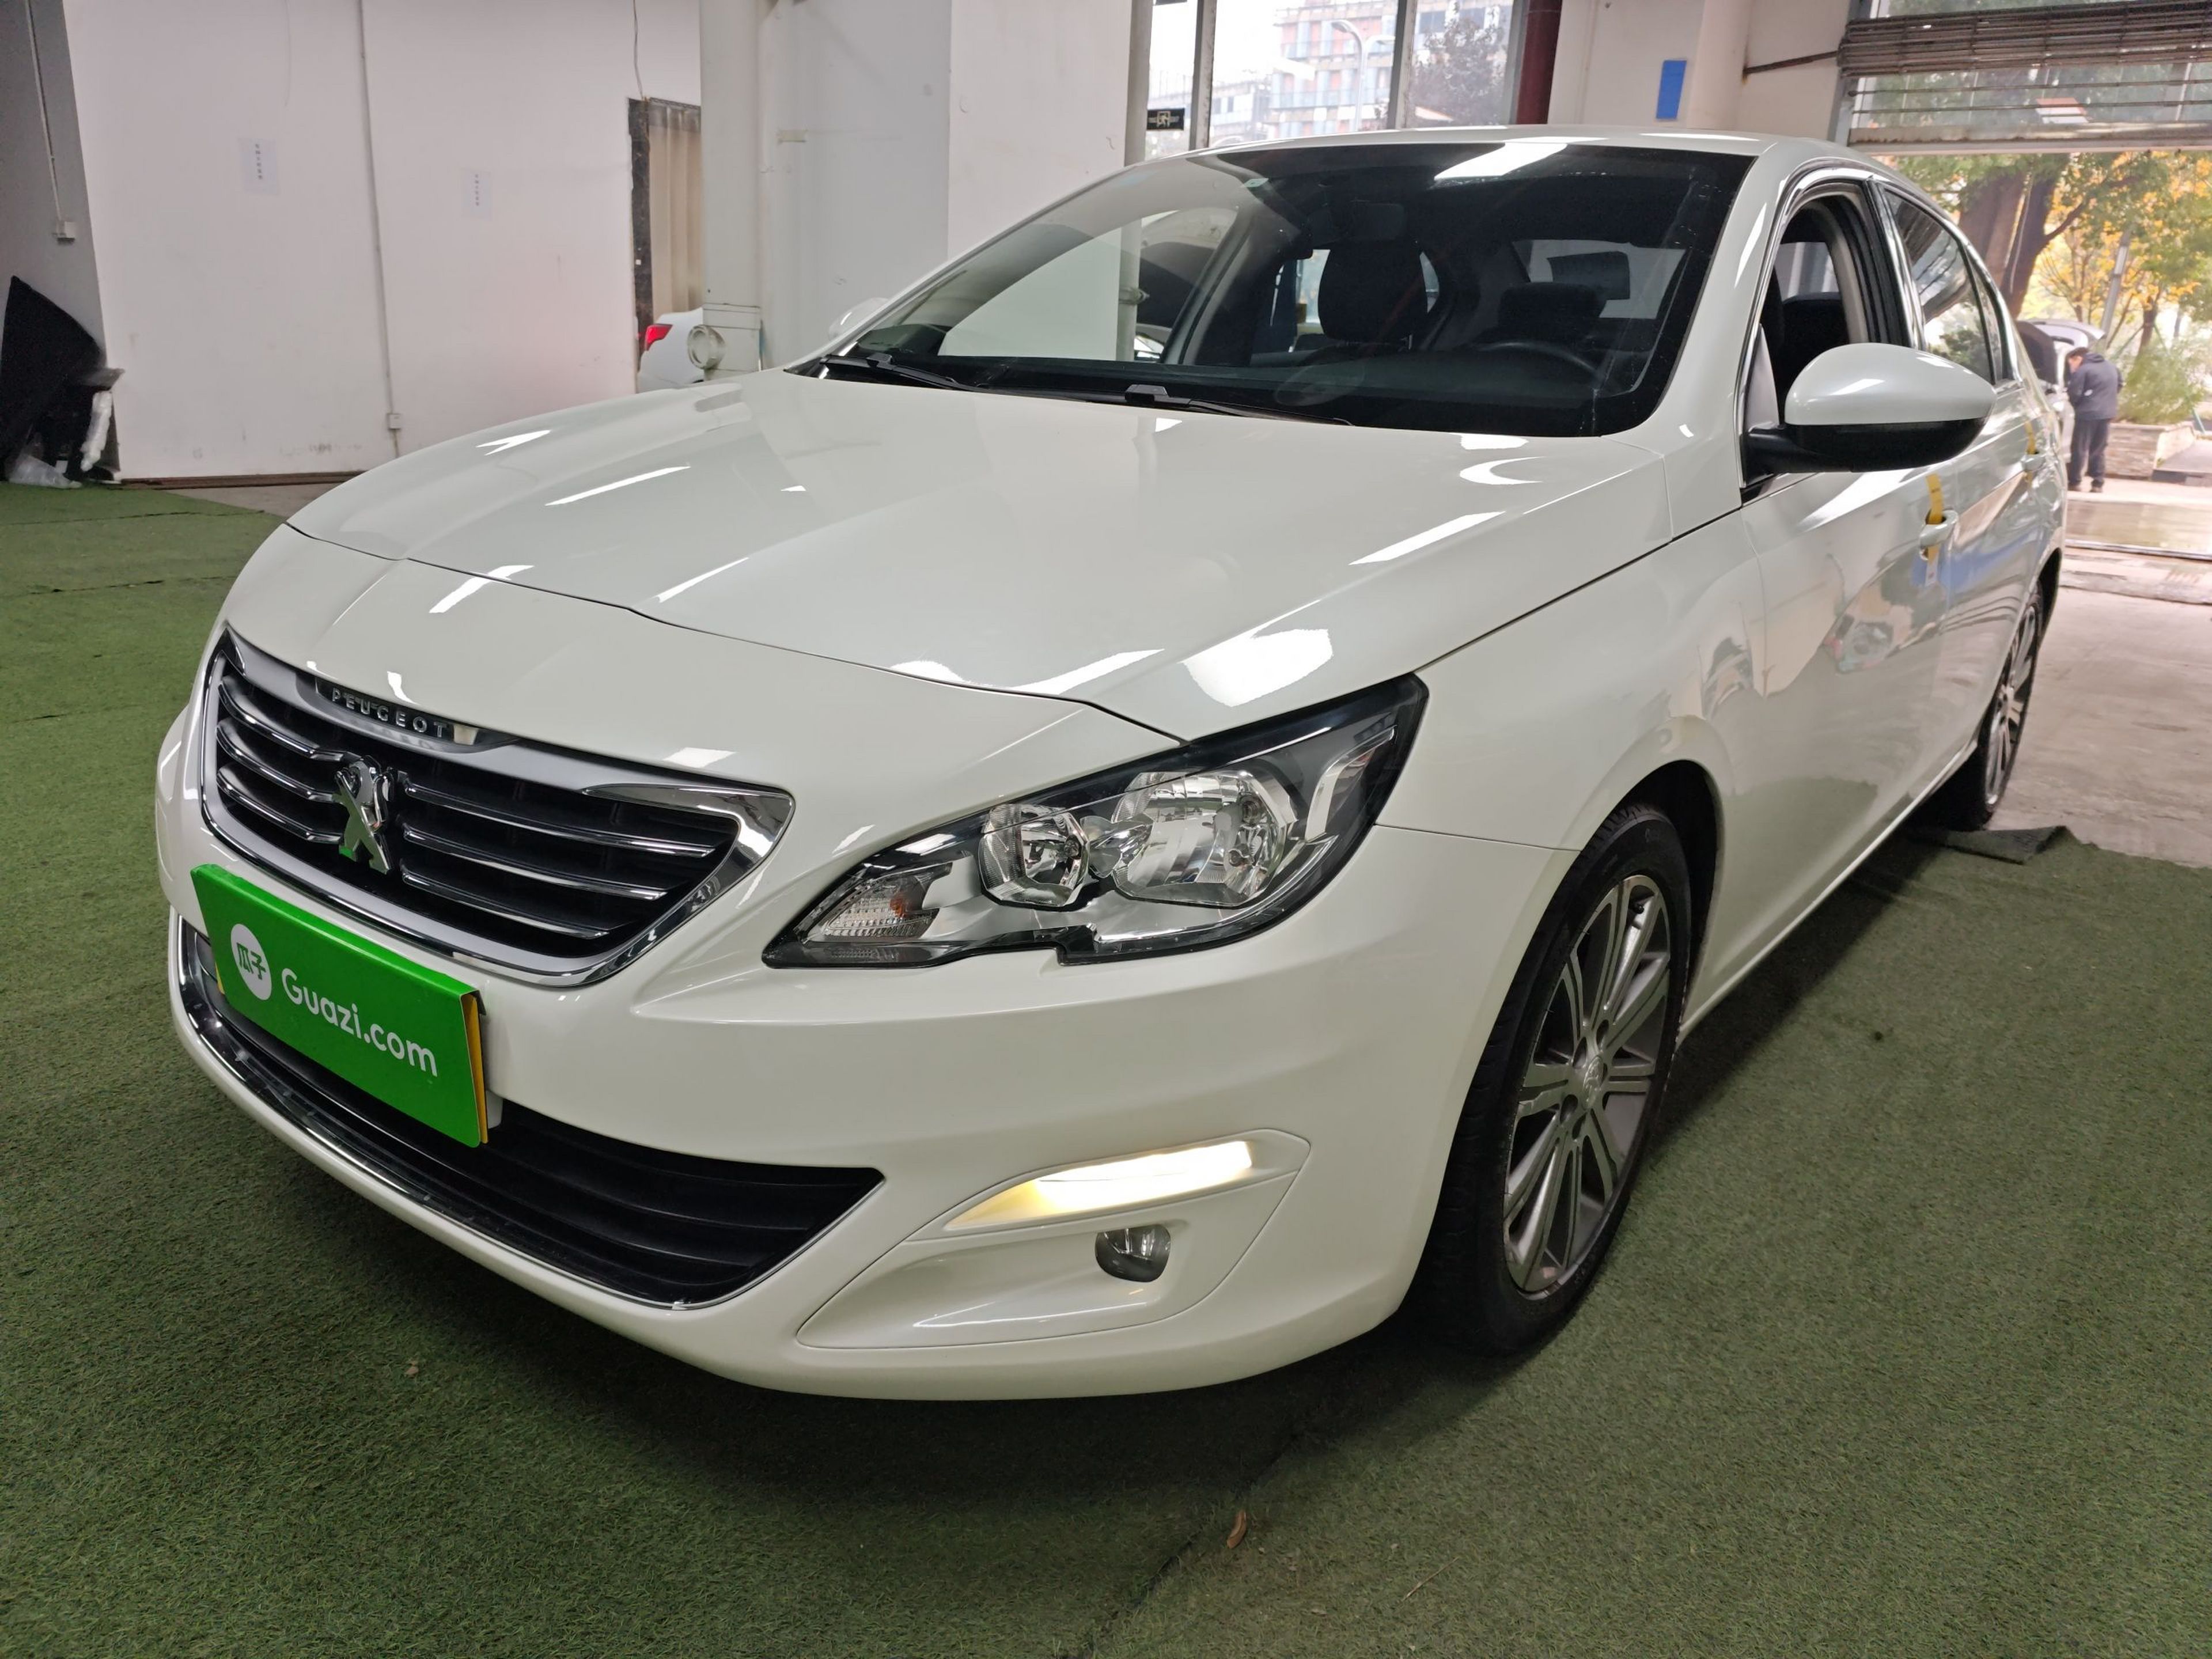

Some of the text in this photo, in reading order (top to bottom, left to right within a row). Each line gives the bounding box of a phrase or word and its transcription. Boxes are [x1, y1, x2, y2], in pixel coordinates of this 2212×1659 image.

[332, 687, 447, 738] PEUGEOT
[236, 942, 267, 980] 瓜子
[281, 968, 438, 1077] Guazi.com
